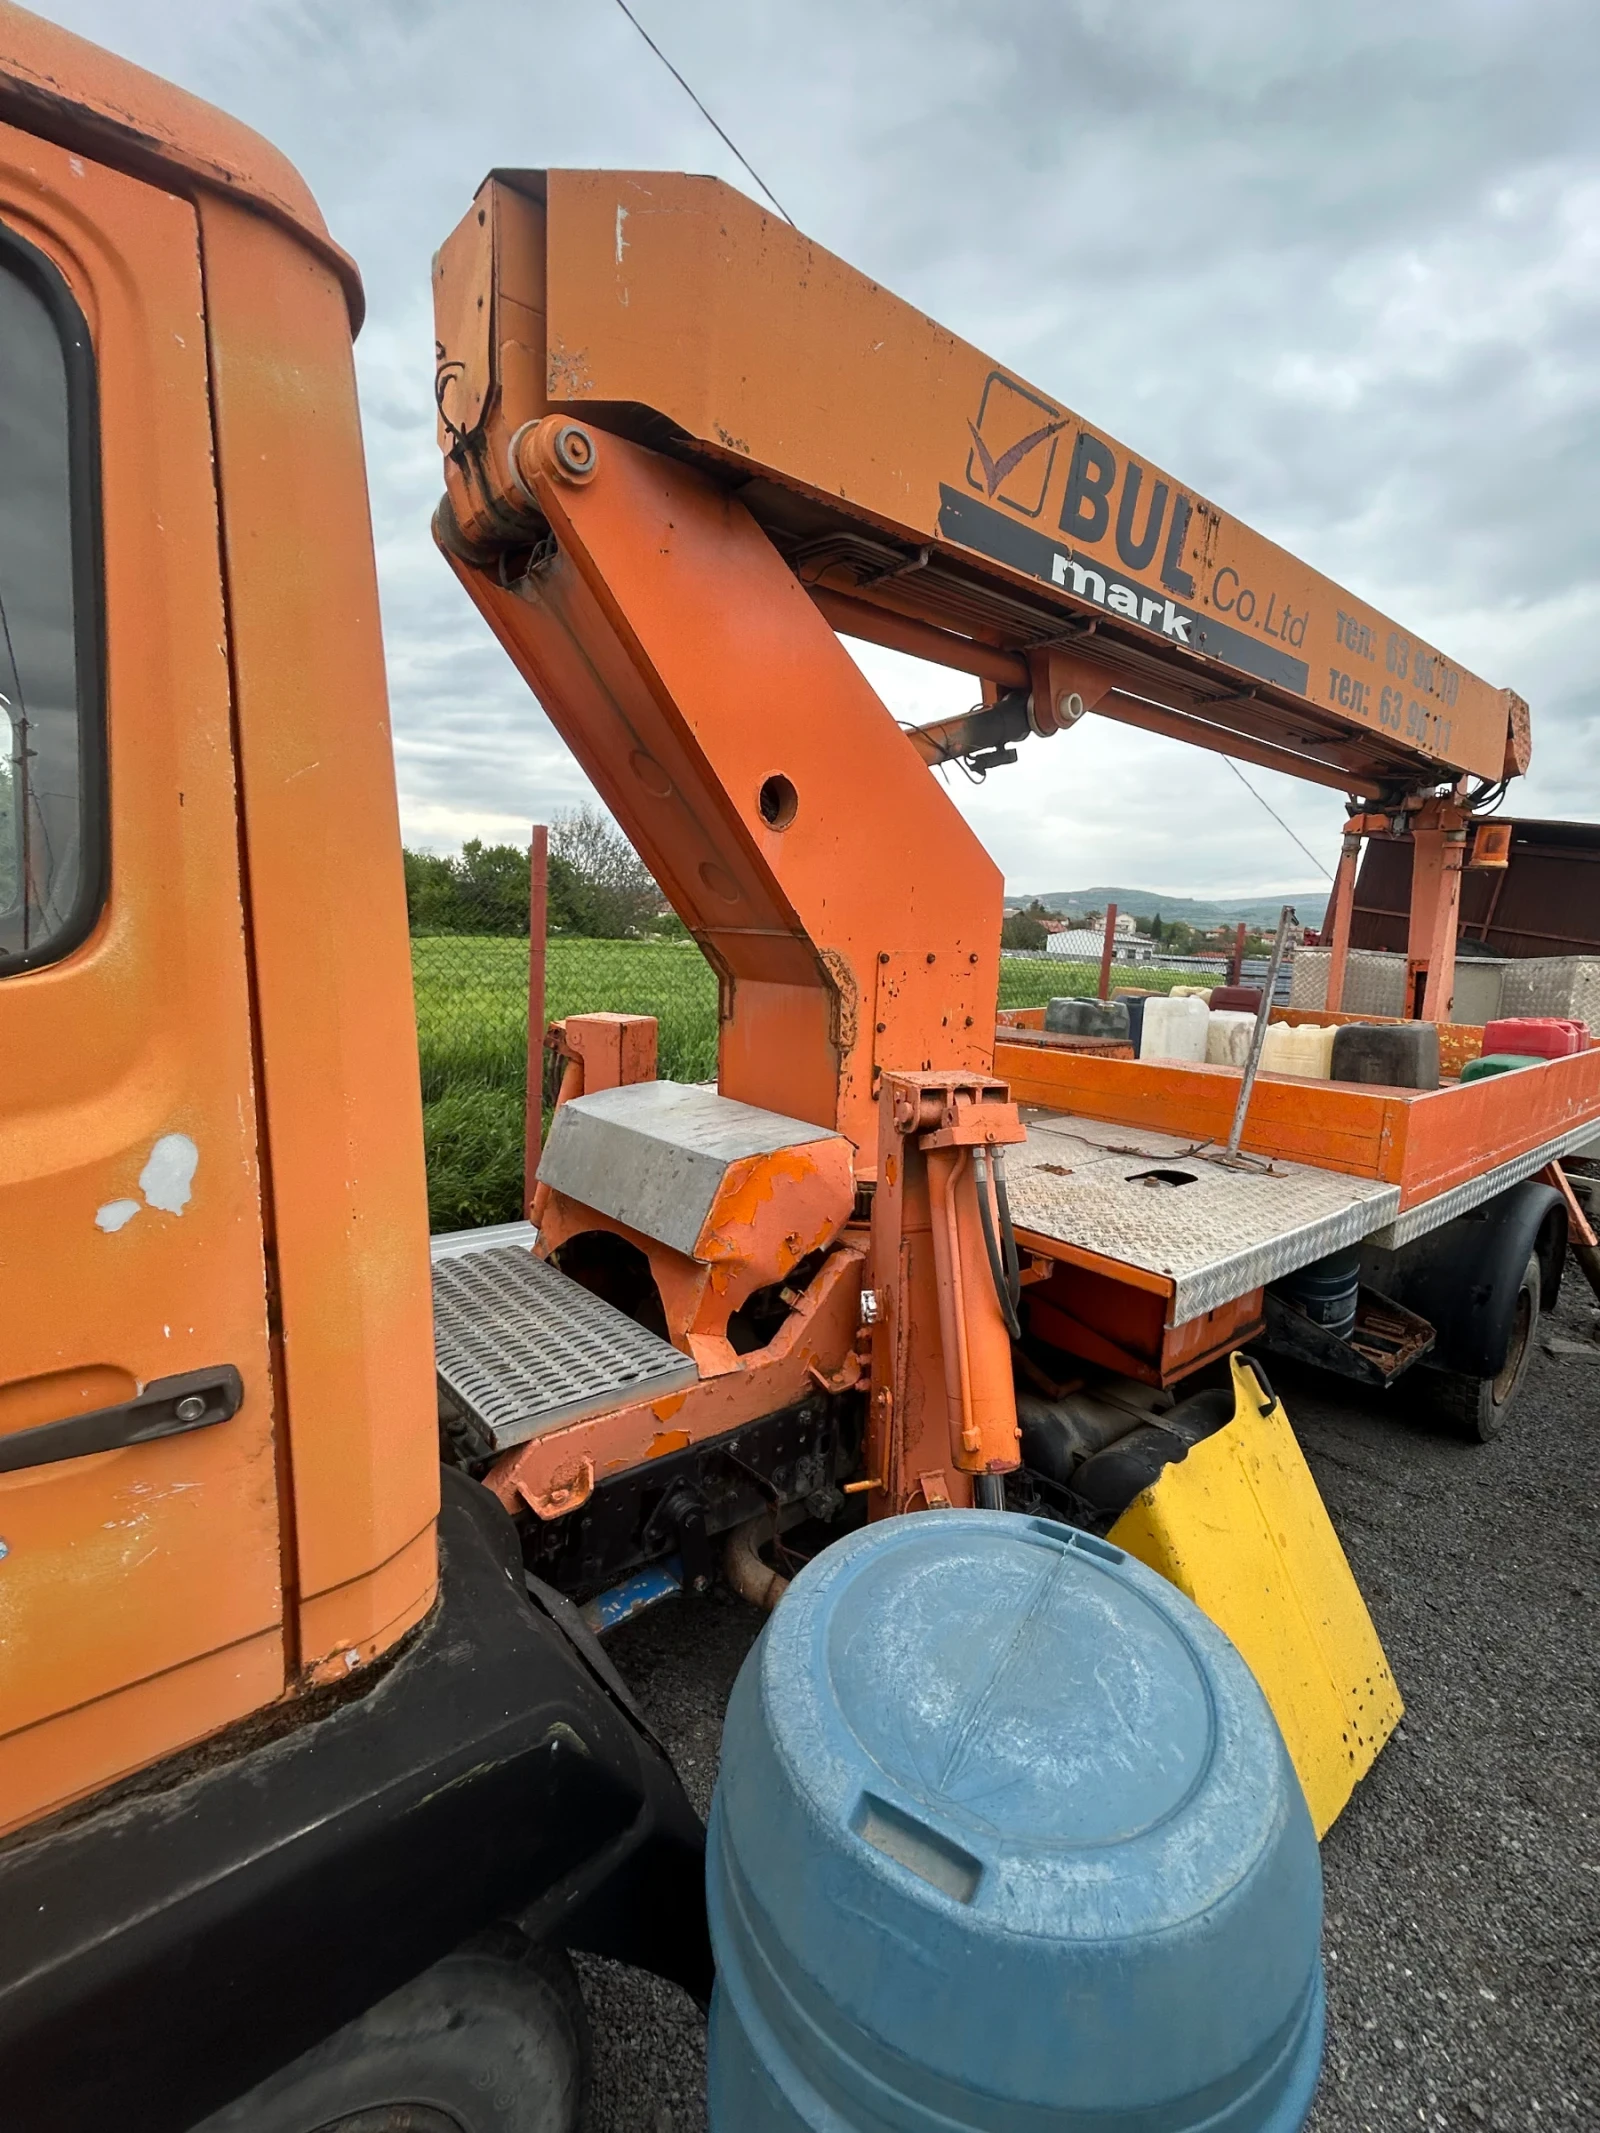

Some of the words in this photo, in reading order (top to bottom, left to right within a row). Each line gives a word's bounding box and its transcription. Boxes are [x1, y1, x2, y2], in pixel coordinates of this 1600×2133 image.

[1059, 432, 1194, 599] BUL
[1212, 566, 1309, 649] Co.Ltd
[1051, 552, 1192, 643] mark
[1386, 632, 1410, 680] 63
[1379, 685, 1403, 731] 63
[1433, 714, 1452, 754] 11
